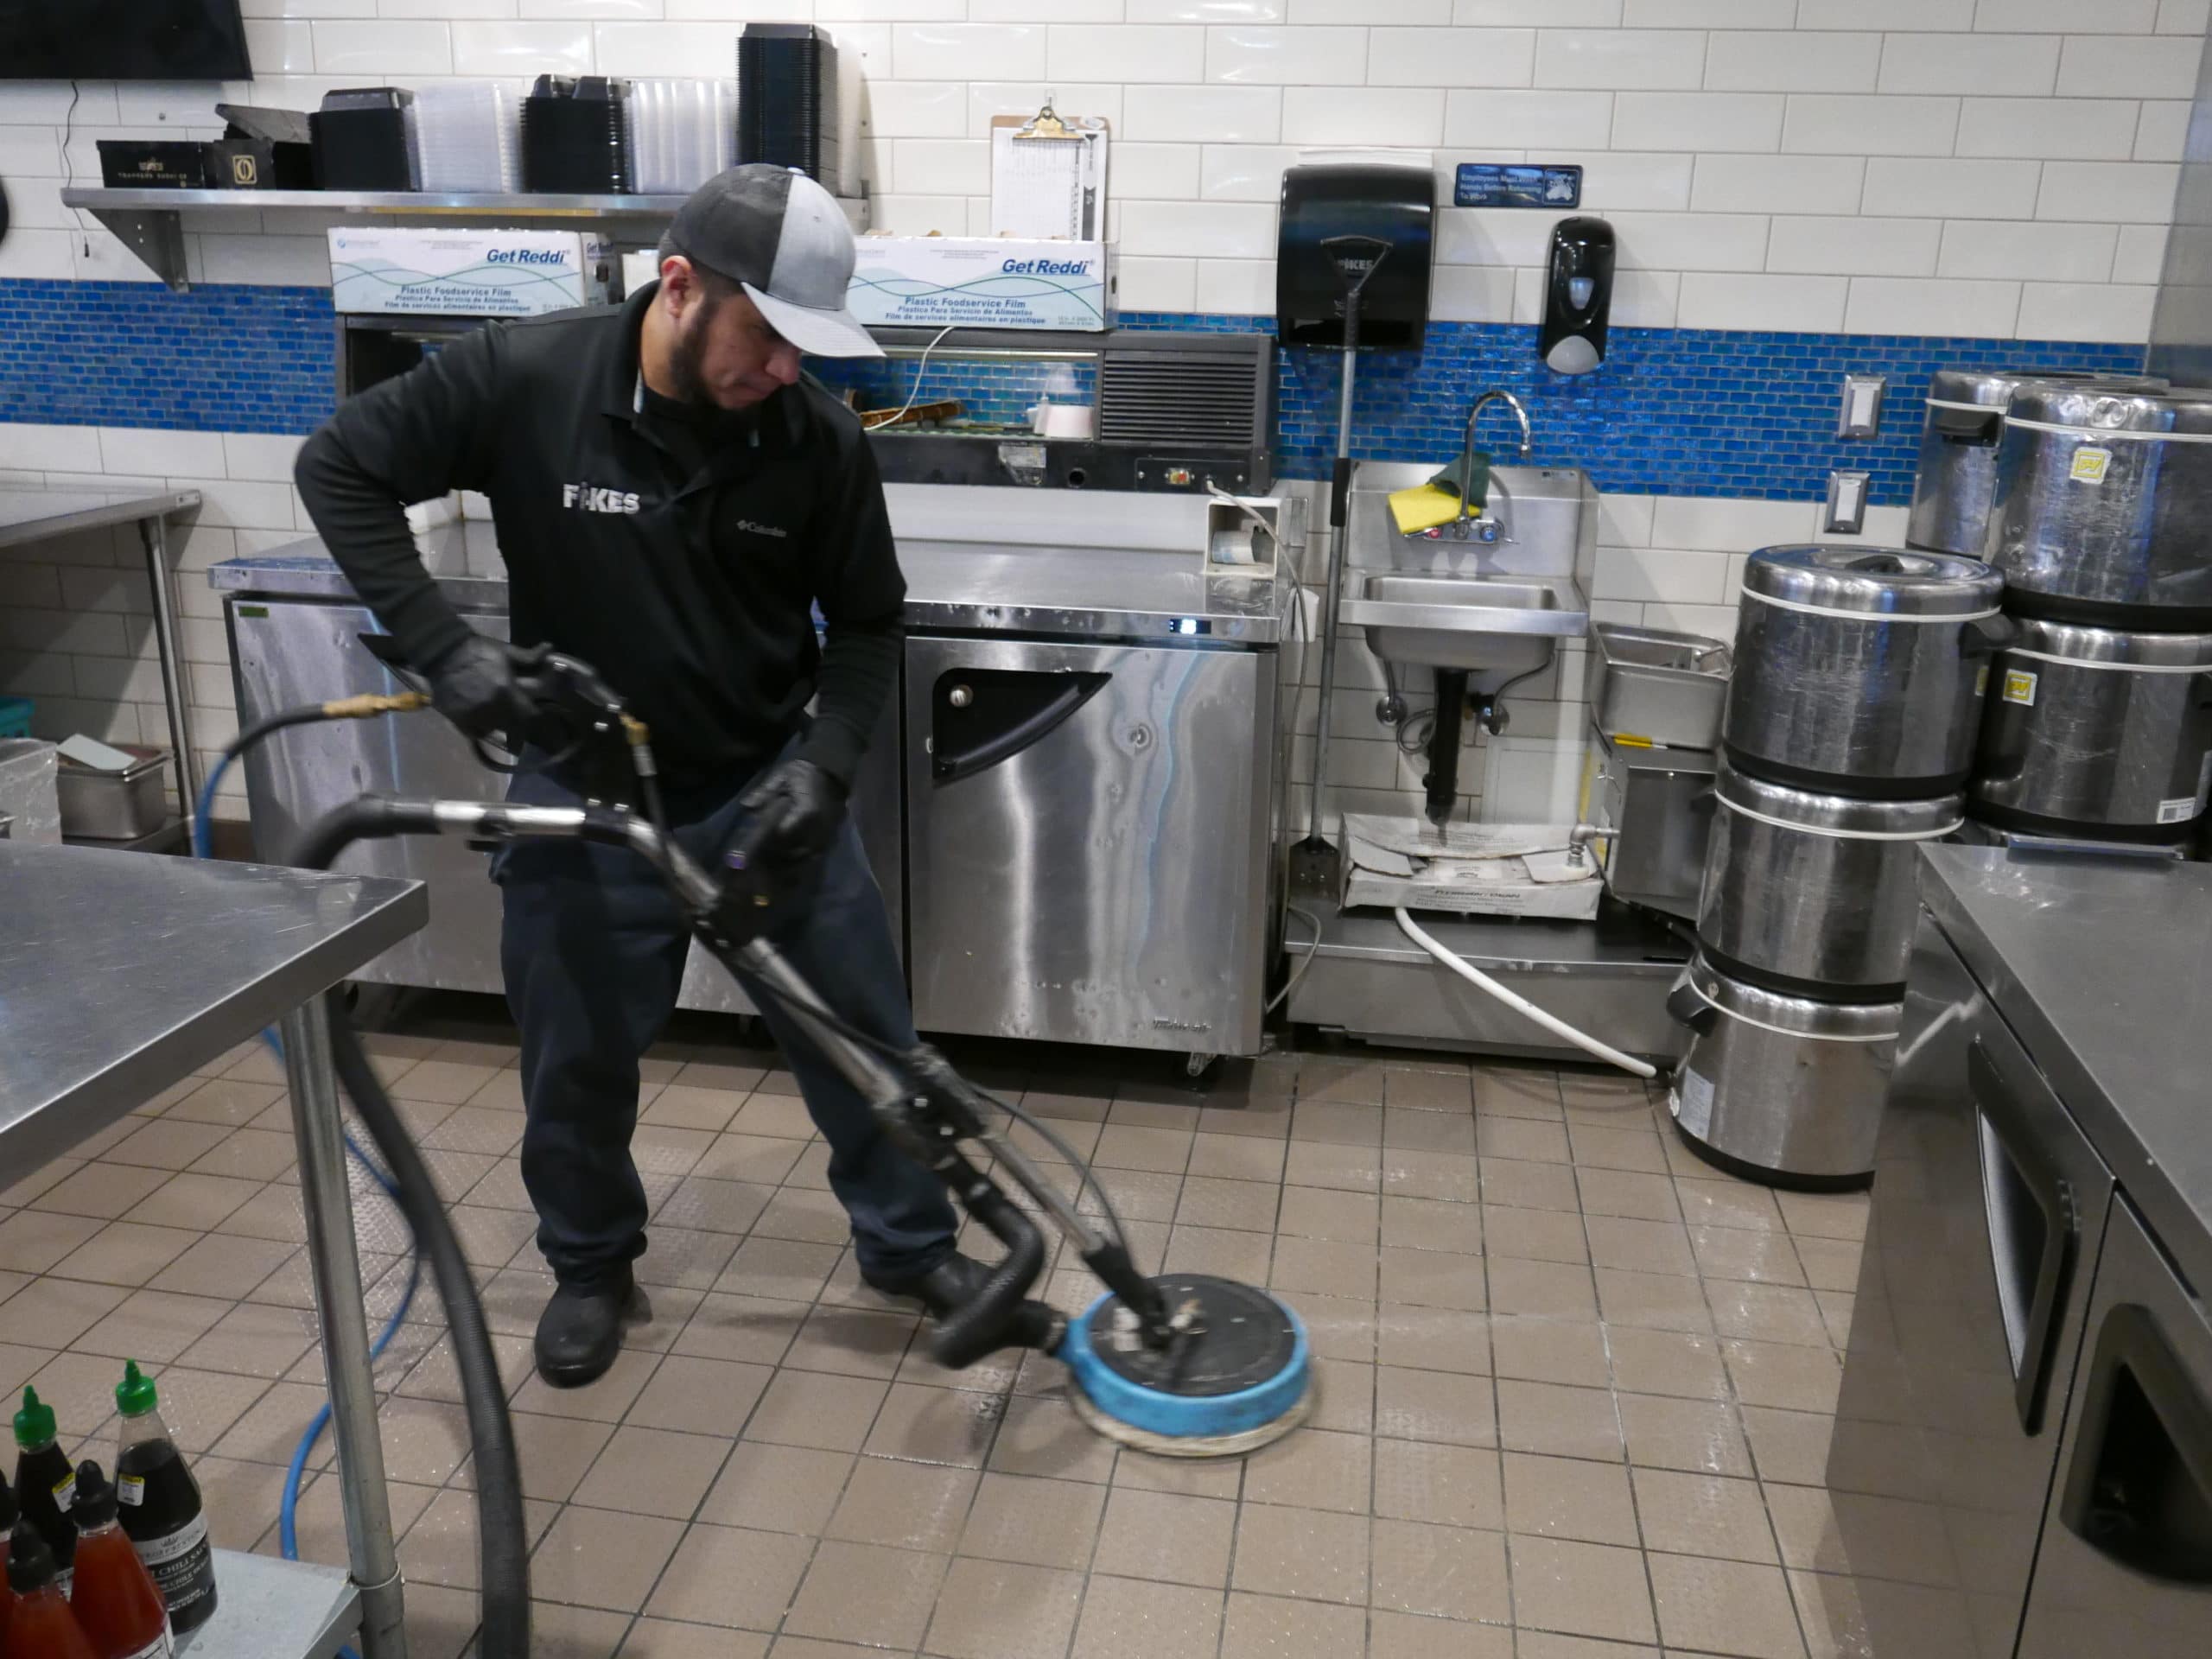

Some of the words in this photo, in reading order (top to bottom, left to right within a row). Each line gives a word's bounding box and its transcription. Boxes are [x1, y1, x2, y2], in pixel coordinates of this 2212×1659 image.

[486, 249, 517, 264] Get
[518, 249, 565, 264] Reddi
[1002, 258, 1034, 273] Get
[1036, 259, 1088, 275] Reddi
[401, 284, 432, 296] Plastic
[434, 286, 489, 296] Foodservice
[492, 288, 512, 297] Film
[905, 296, 938, 306] Plastic
[941, 297, 1001, 308] Foodservice
[1004, 299, 1026, 308] Film
